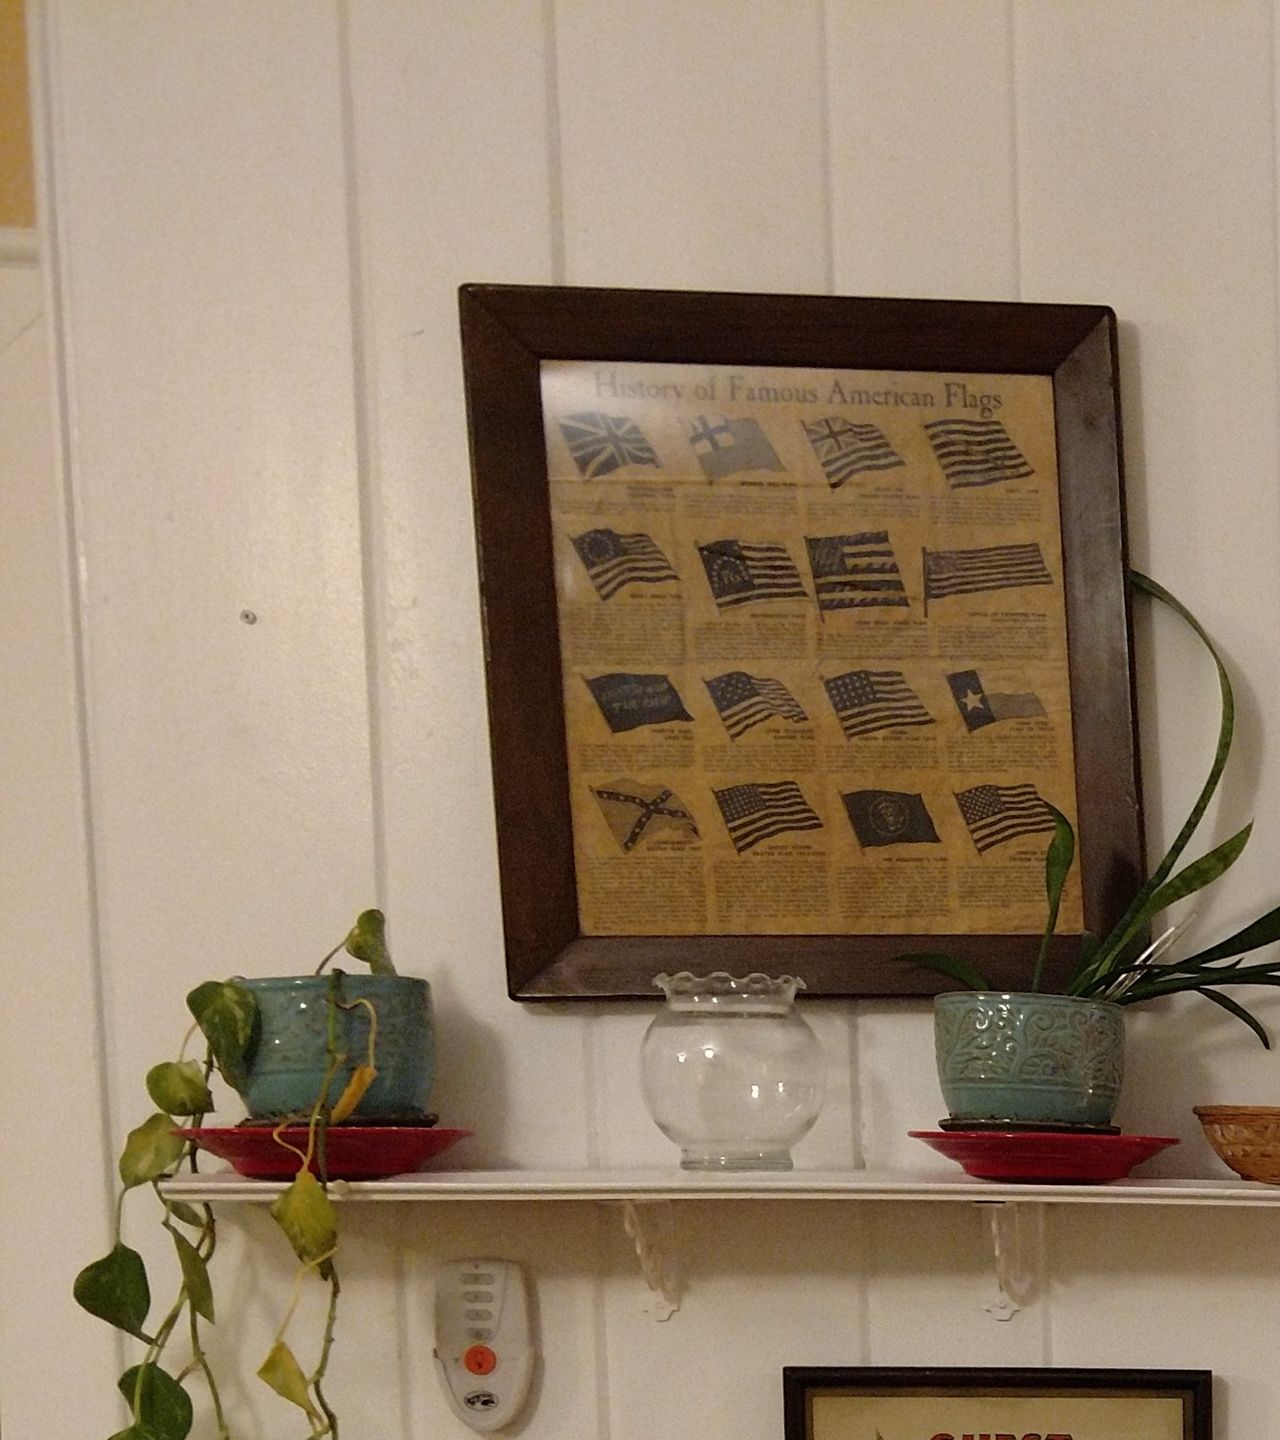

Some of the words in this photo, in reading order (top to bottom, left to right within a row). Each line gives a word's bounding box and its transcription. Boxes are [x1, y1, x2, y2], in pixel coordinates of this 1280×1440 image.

[595, 371, 682, 403] History
[695, 375, 716, 400] of
[731, 378, 818, 404] Famous
[831, 380, 935, 408] American
[944, 383, 1002, 419] Flags
